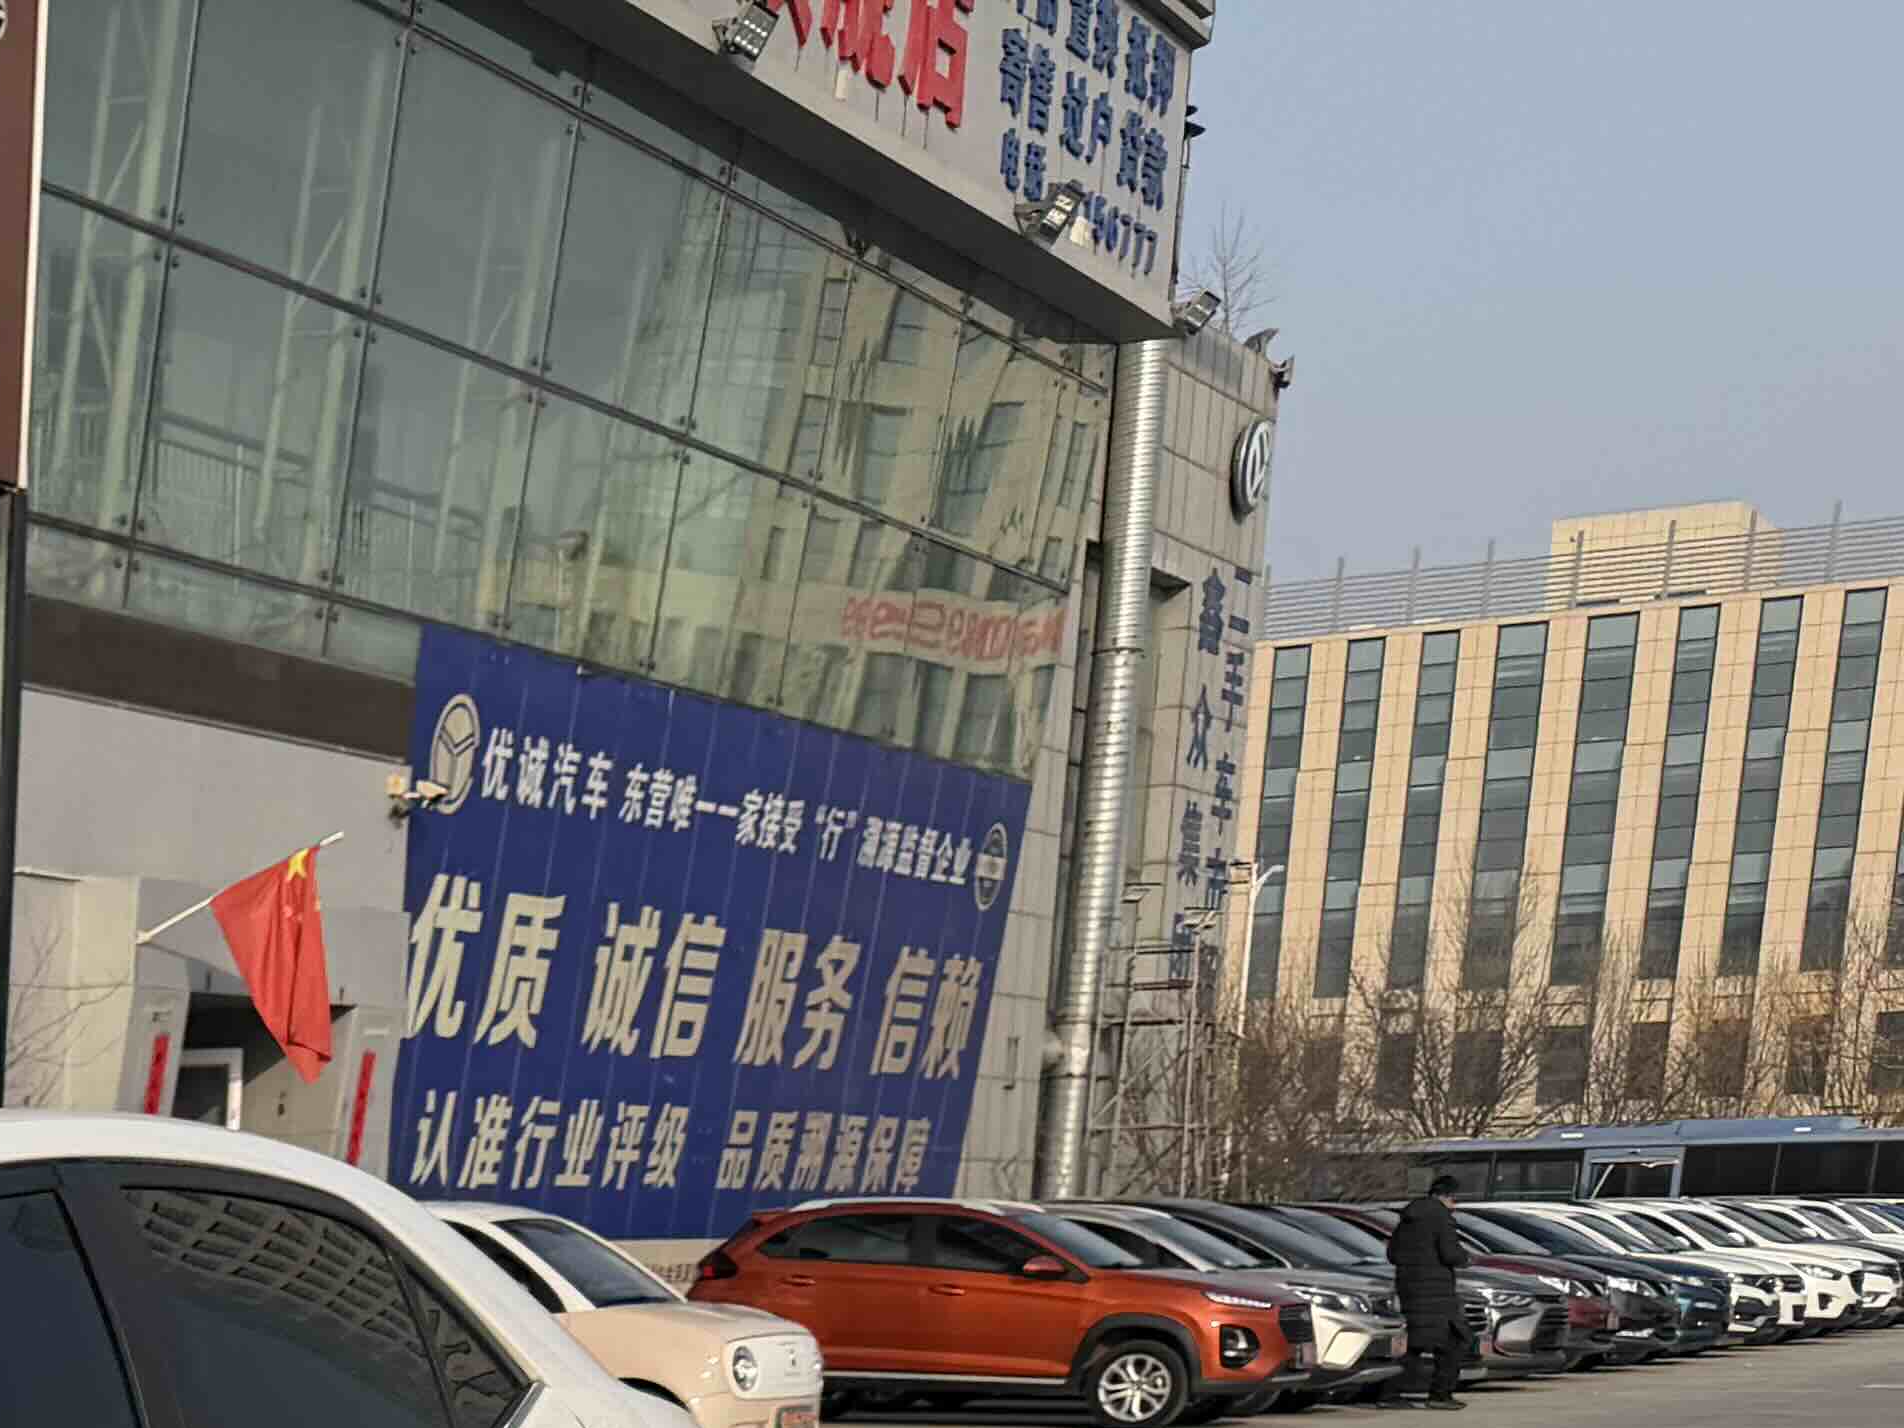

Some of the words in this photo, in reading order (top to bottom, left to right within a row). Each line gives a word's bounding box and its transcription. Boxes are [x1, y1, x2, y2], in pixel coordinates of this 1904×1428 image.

[481, 727, 614, 820] 优诚汽车
[404, 872, 566, 1046] 优质
[582, 900, 726, 1060] 诚信
[732, 928, 863, 1071] 服务
[868, 947, 984, 1080] 信赖
[411, 1090, 691, 1190] 认准行业评级
